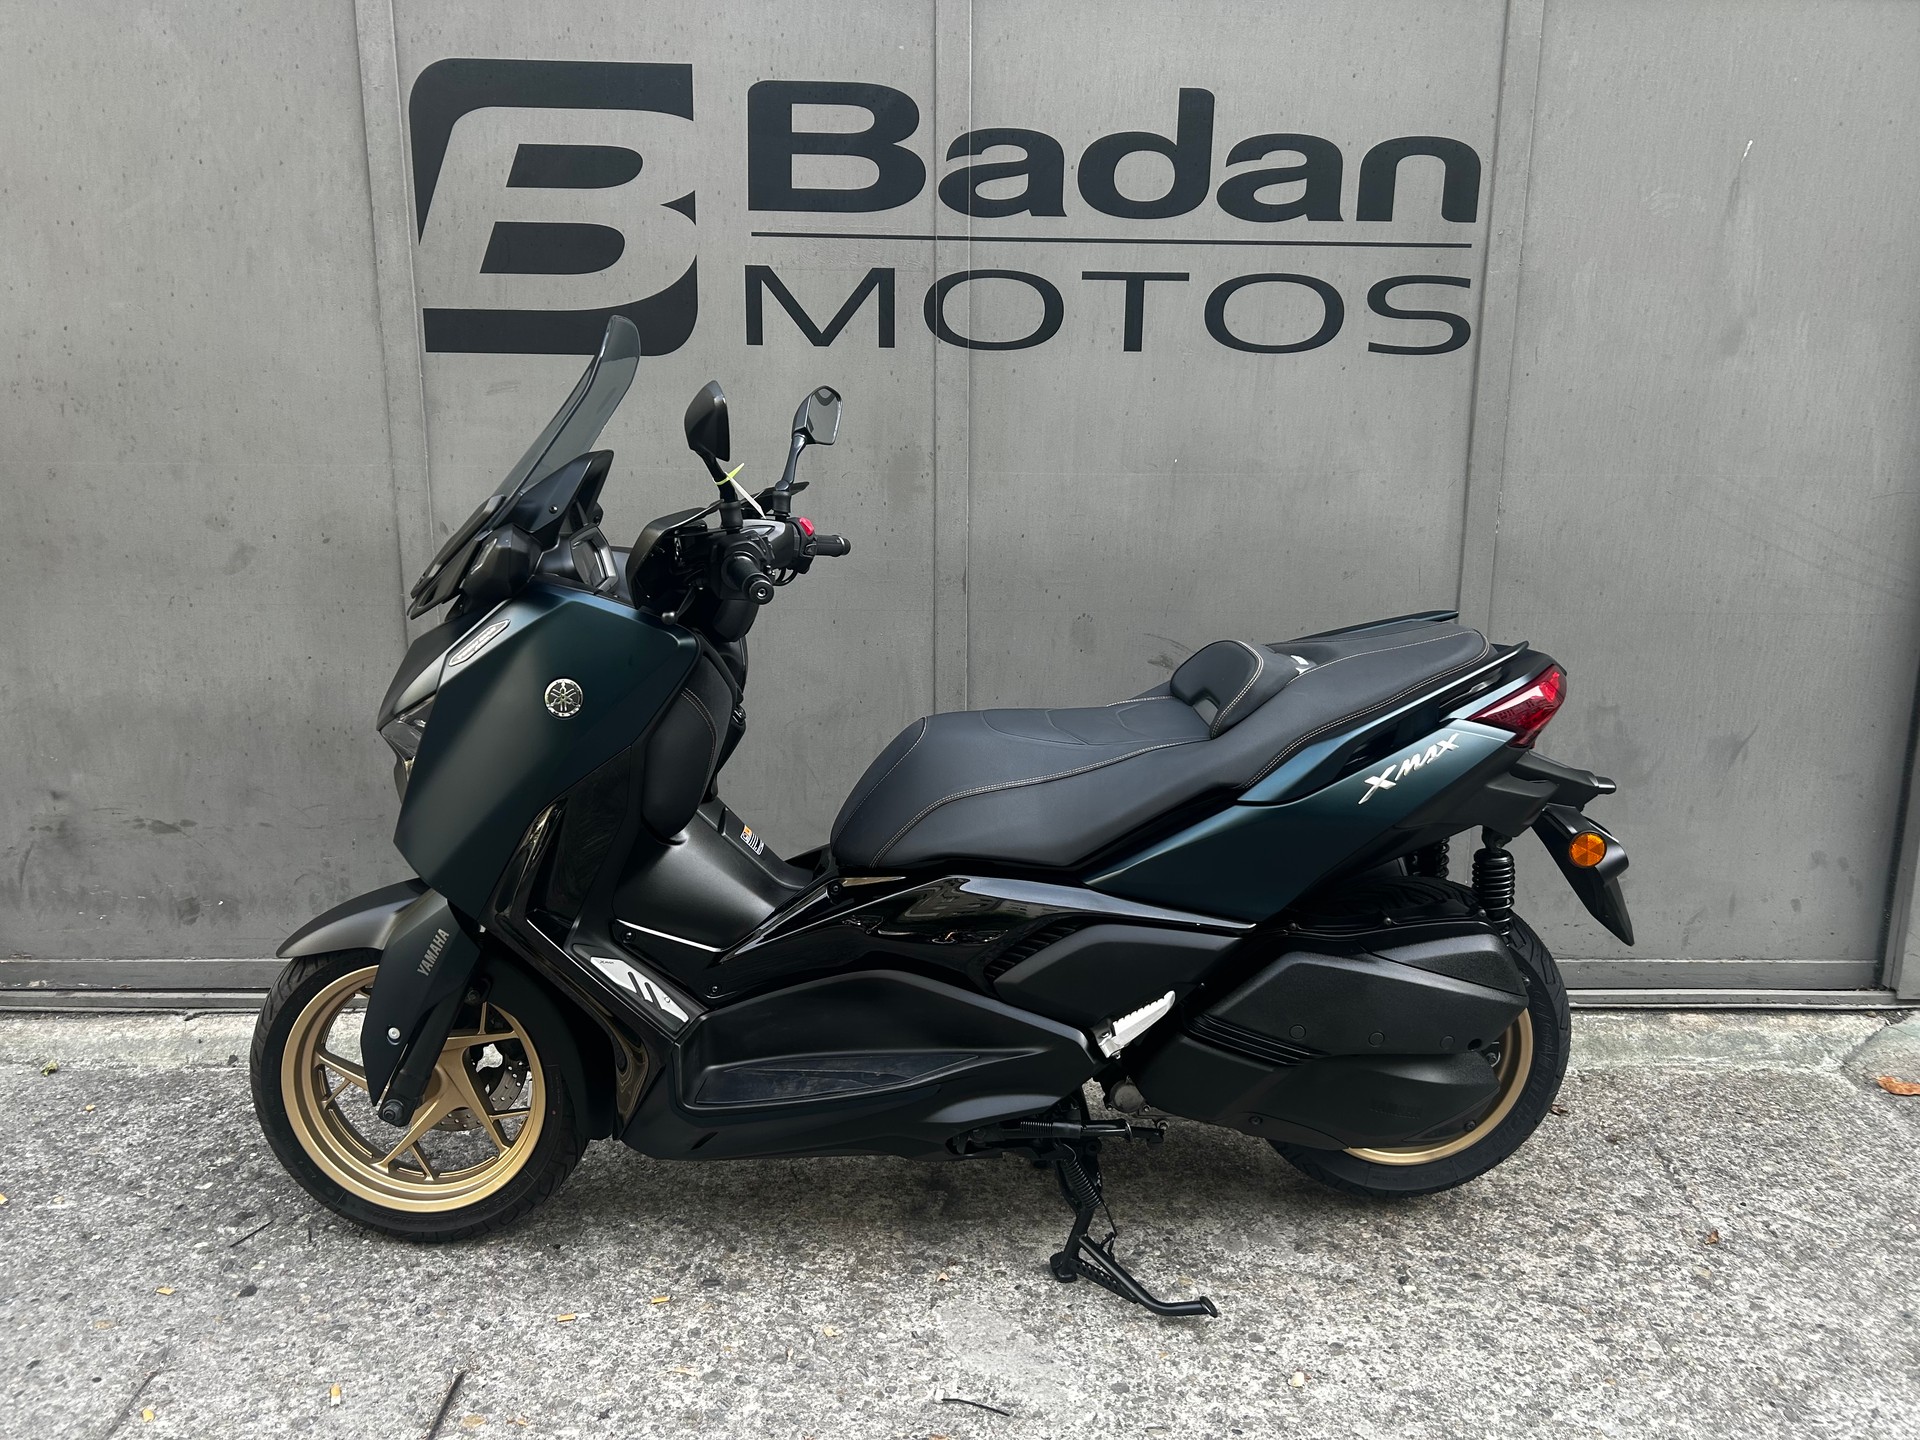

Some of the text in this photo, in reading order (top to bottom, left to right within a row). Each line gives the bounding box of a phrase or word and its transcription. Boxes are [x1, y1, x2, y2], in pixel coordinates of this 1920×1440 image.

[747, 80, 1482, 223] Badan
[744, 264, 1471, 355] MOTOS
[416, 928, 450, 977] YAMAHA
